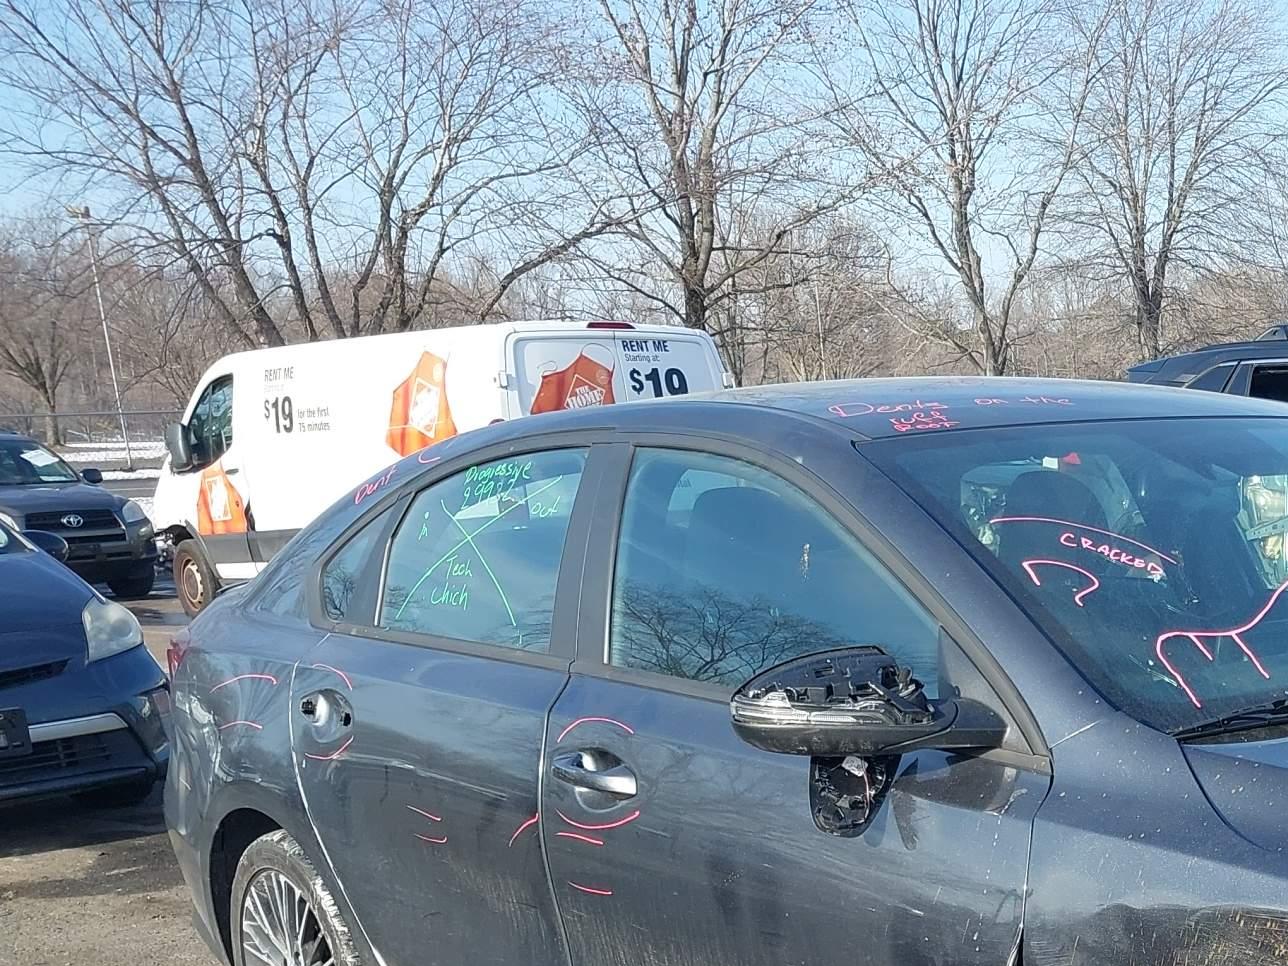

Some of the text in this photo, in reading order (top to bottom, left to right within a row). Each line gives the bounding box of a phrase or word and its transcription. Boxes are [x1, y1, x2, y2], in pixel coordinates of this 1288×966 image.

[621, 340, 670, 353] RENT ME
[624, 353, 648, 362] Starting
[264, 366, 294, 382] RENT ME
[263, 396, 294, 433] $19
[297, 406, 329, 419] for the first
[307, 421, 330, 431] minutes
[1060, 533, 1163, 574] CRACKED
